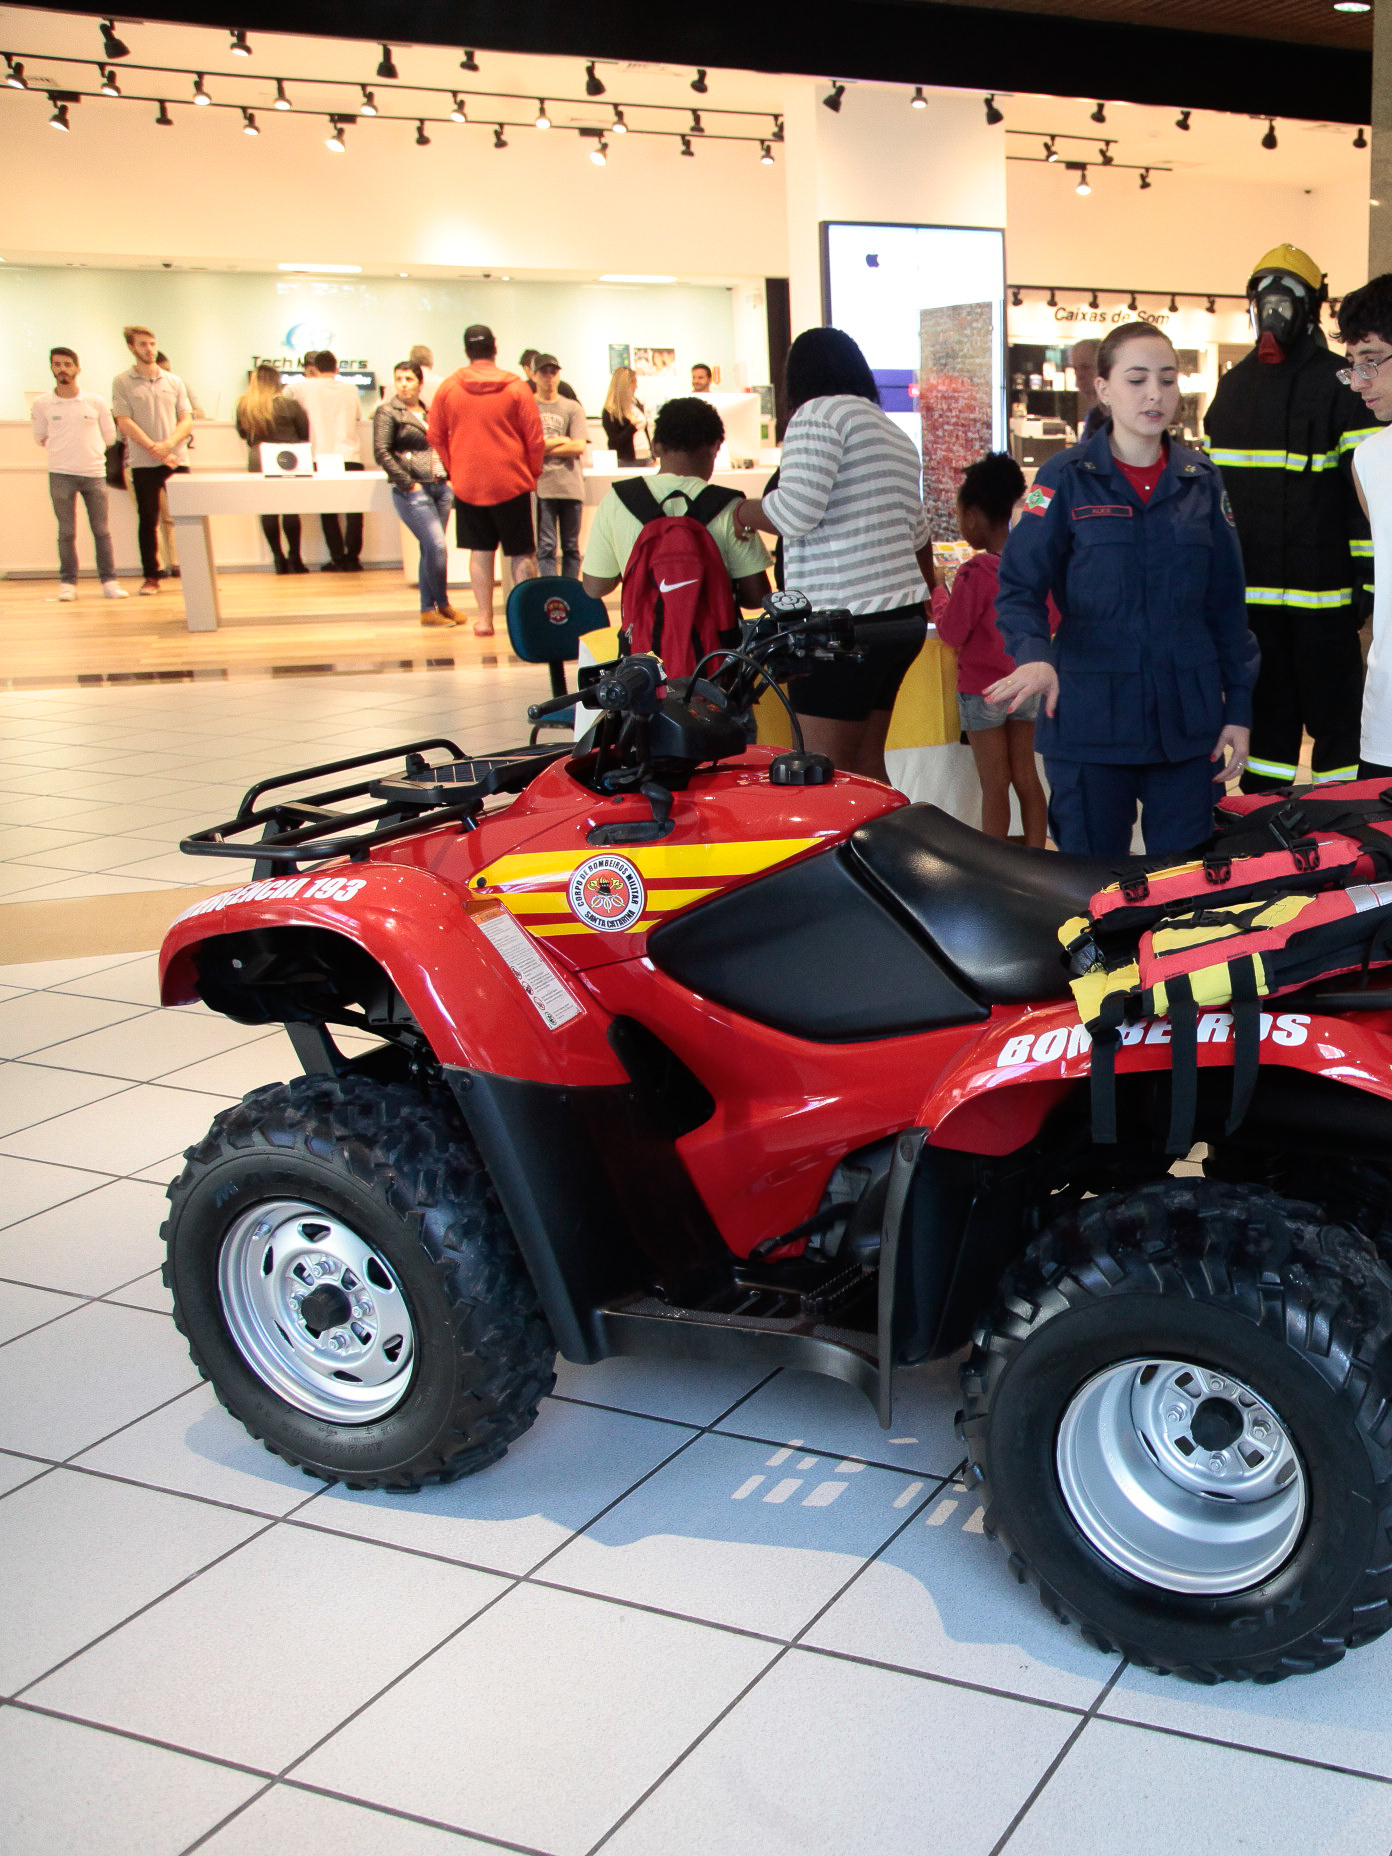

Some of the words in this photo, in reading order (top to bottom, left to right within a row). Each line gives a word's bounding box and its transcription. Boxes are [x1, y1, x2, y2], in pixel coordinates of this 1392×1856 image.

[1055, 307, 1107, 323] Caixas
[1111, 311, 1131, 324] de
[1136, 310, 1170, 325] Som
[252, 356, 293, 369] Tech
[303, 877, 368, 902] 193
[574, 880, 585, 907] CORPO
[580, 869, 589, 880] DE
[588, 859, 629, 875] BOMBEIROS
[625, 873, 639, 905] MILITAR
[584, 910, 606, 928] SANTA
[606, 909, 636, 928] CATARINA
